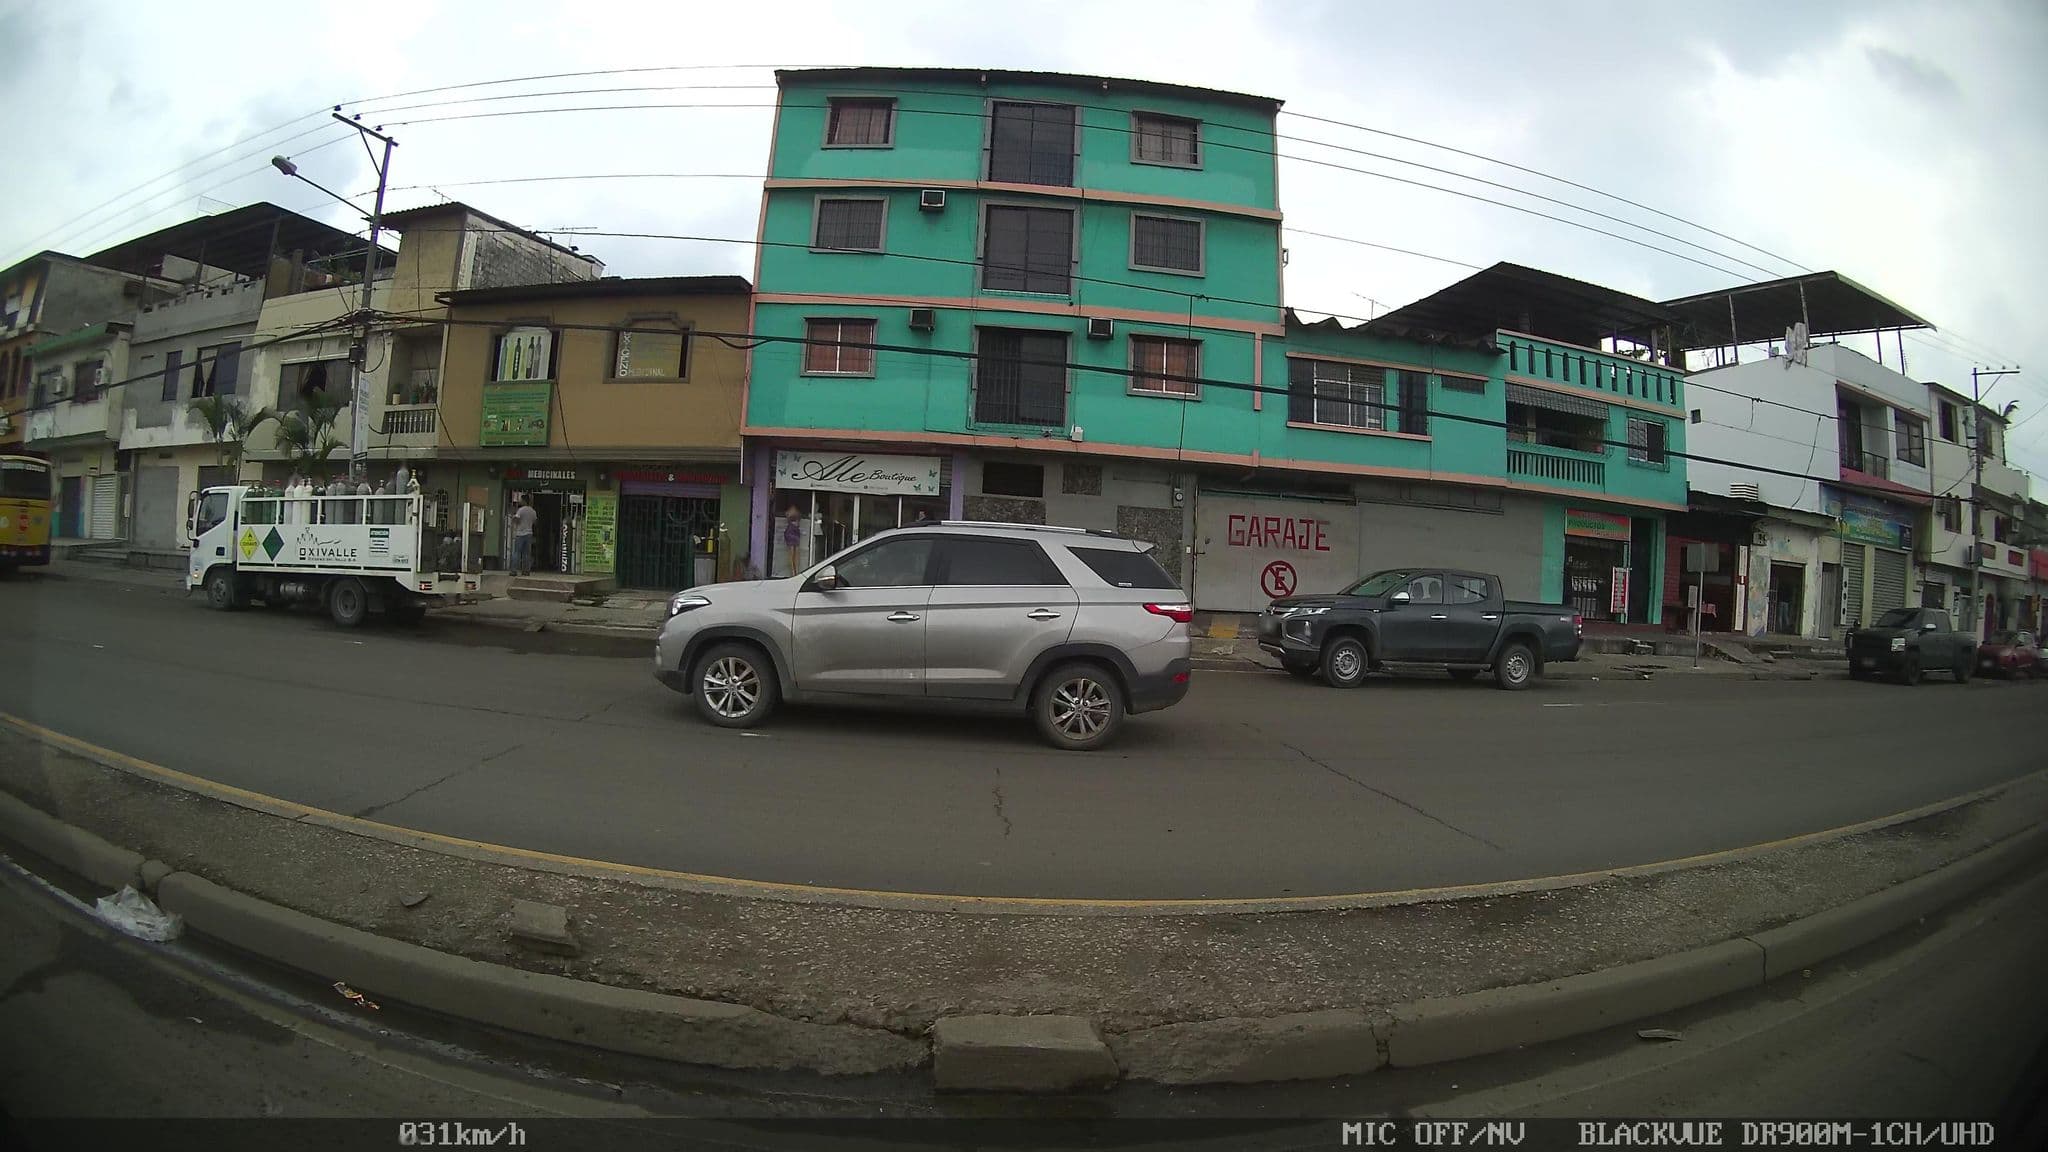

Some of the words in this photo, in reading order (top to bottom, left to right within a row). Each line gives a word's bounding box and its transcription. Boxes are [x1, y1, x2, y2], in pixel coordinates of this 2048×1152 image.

[528, 470, 575, 479] MEDICINALES
[792, 455, 868, 483] Ale
[869, 469, 917, 485] Boutique
[668, 473, 675, 481] &
[1228, 515, 1330, 551] GARAJE
[299, 547, 357, 557] OXIVALLE
